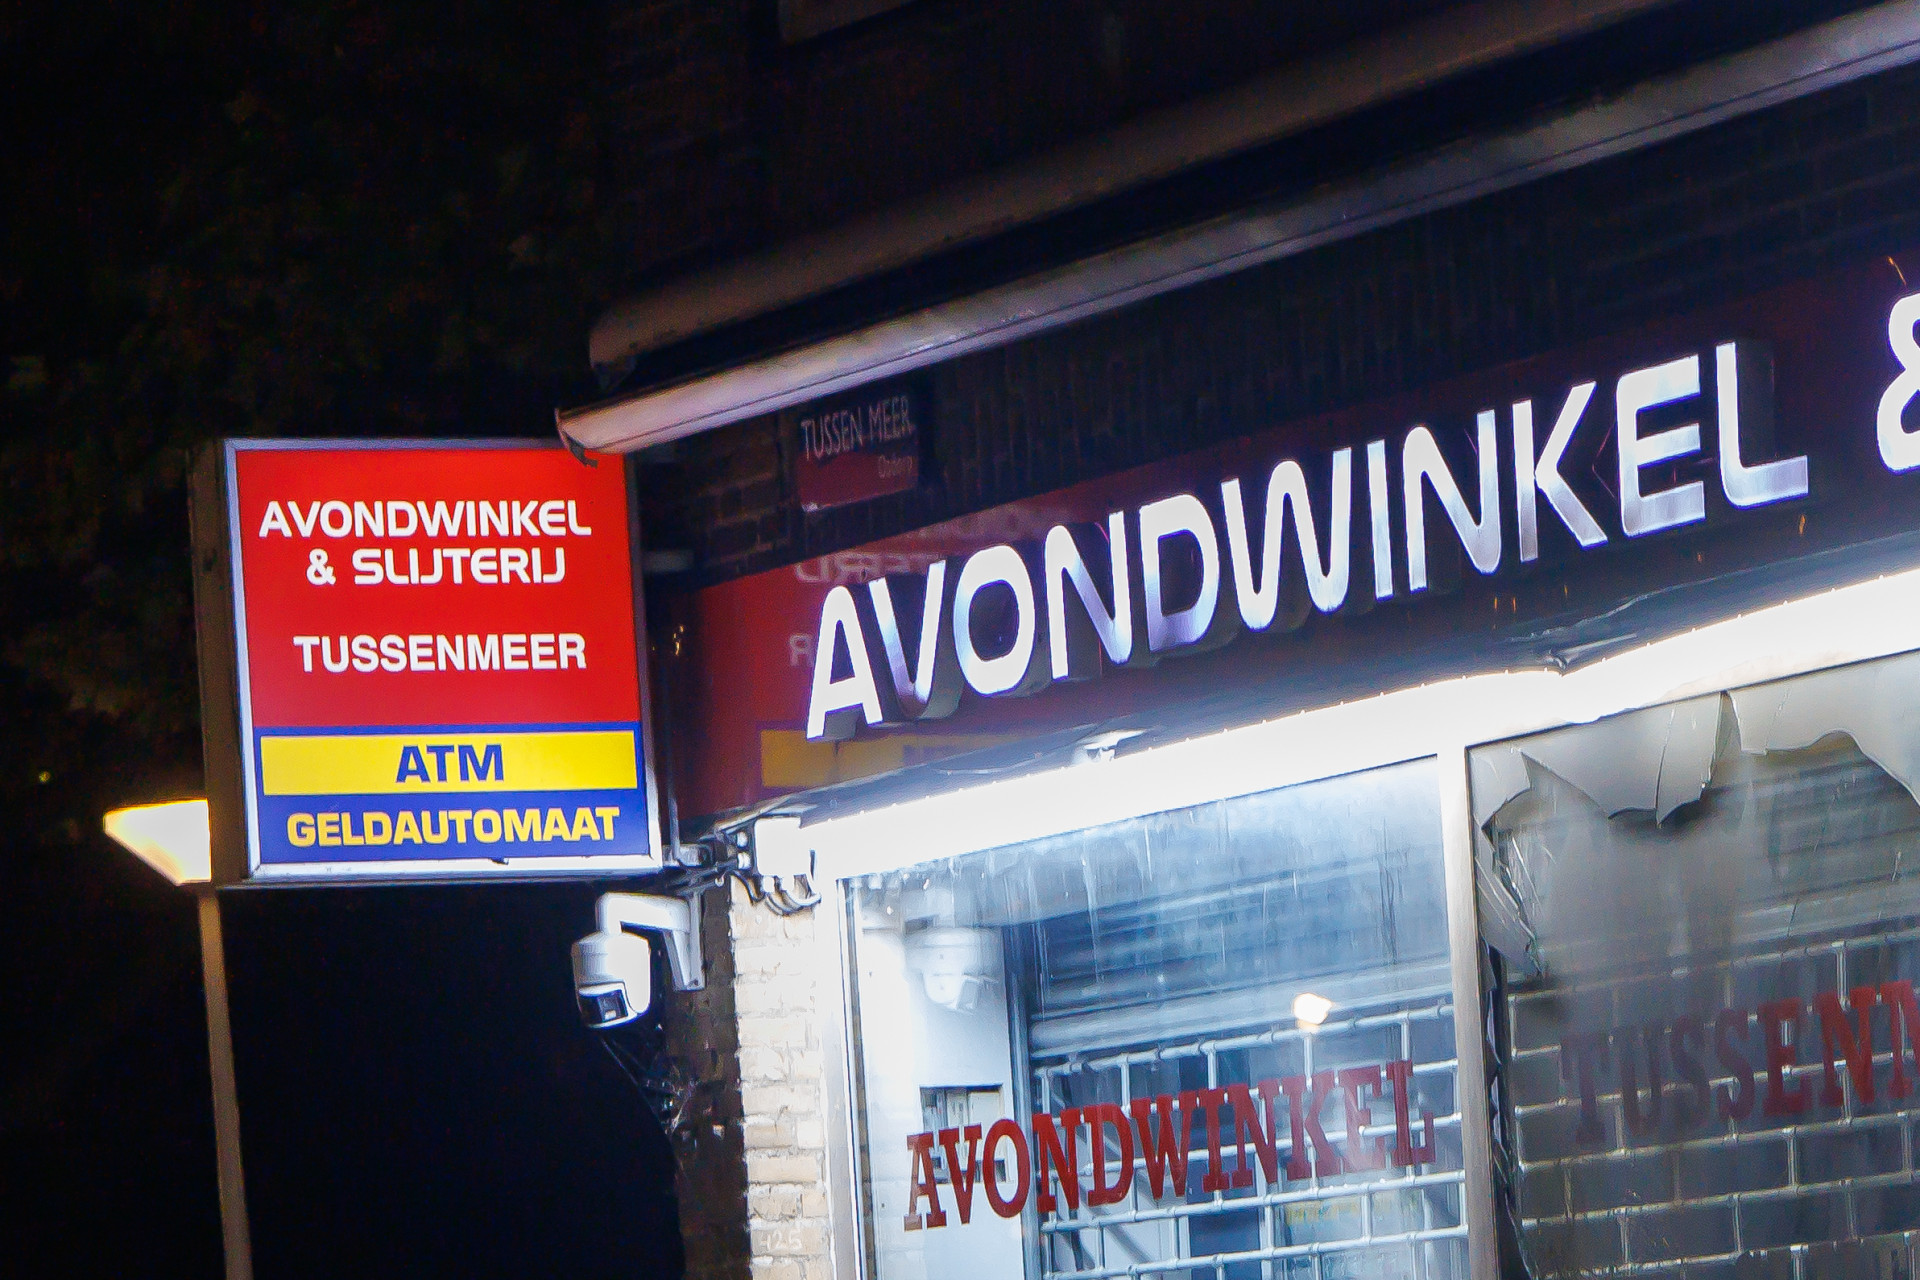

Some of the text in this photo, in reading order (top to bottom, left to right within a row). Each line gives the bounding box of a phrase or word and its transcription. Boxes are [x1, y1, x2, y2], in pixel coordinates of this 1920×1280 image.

[801, 396, 915, 461] TUSSEN MEER
[258, 500, 593, 539] AVONDWINKEL
[806, 340, 1809, 739] AVONDWINKEL
[306, 547, 566, 586] & SLIJTERIJ
[293, 633, 587, 673] TUSSENMEER
[395, 743, 505, 784] ATM
[286, 806, 620, 847] GELDAUTOMAAT
[904, 1059, 1436, 1232] AVONDWINKEL
